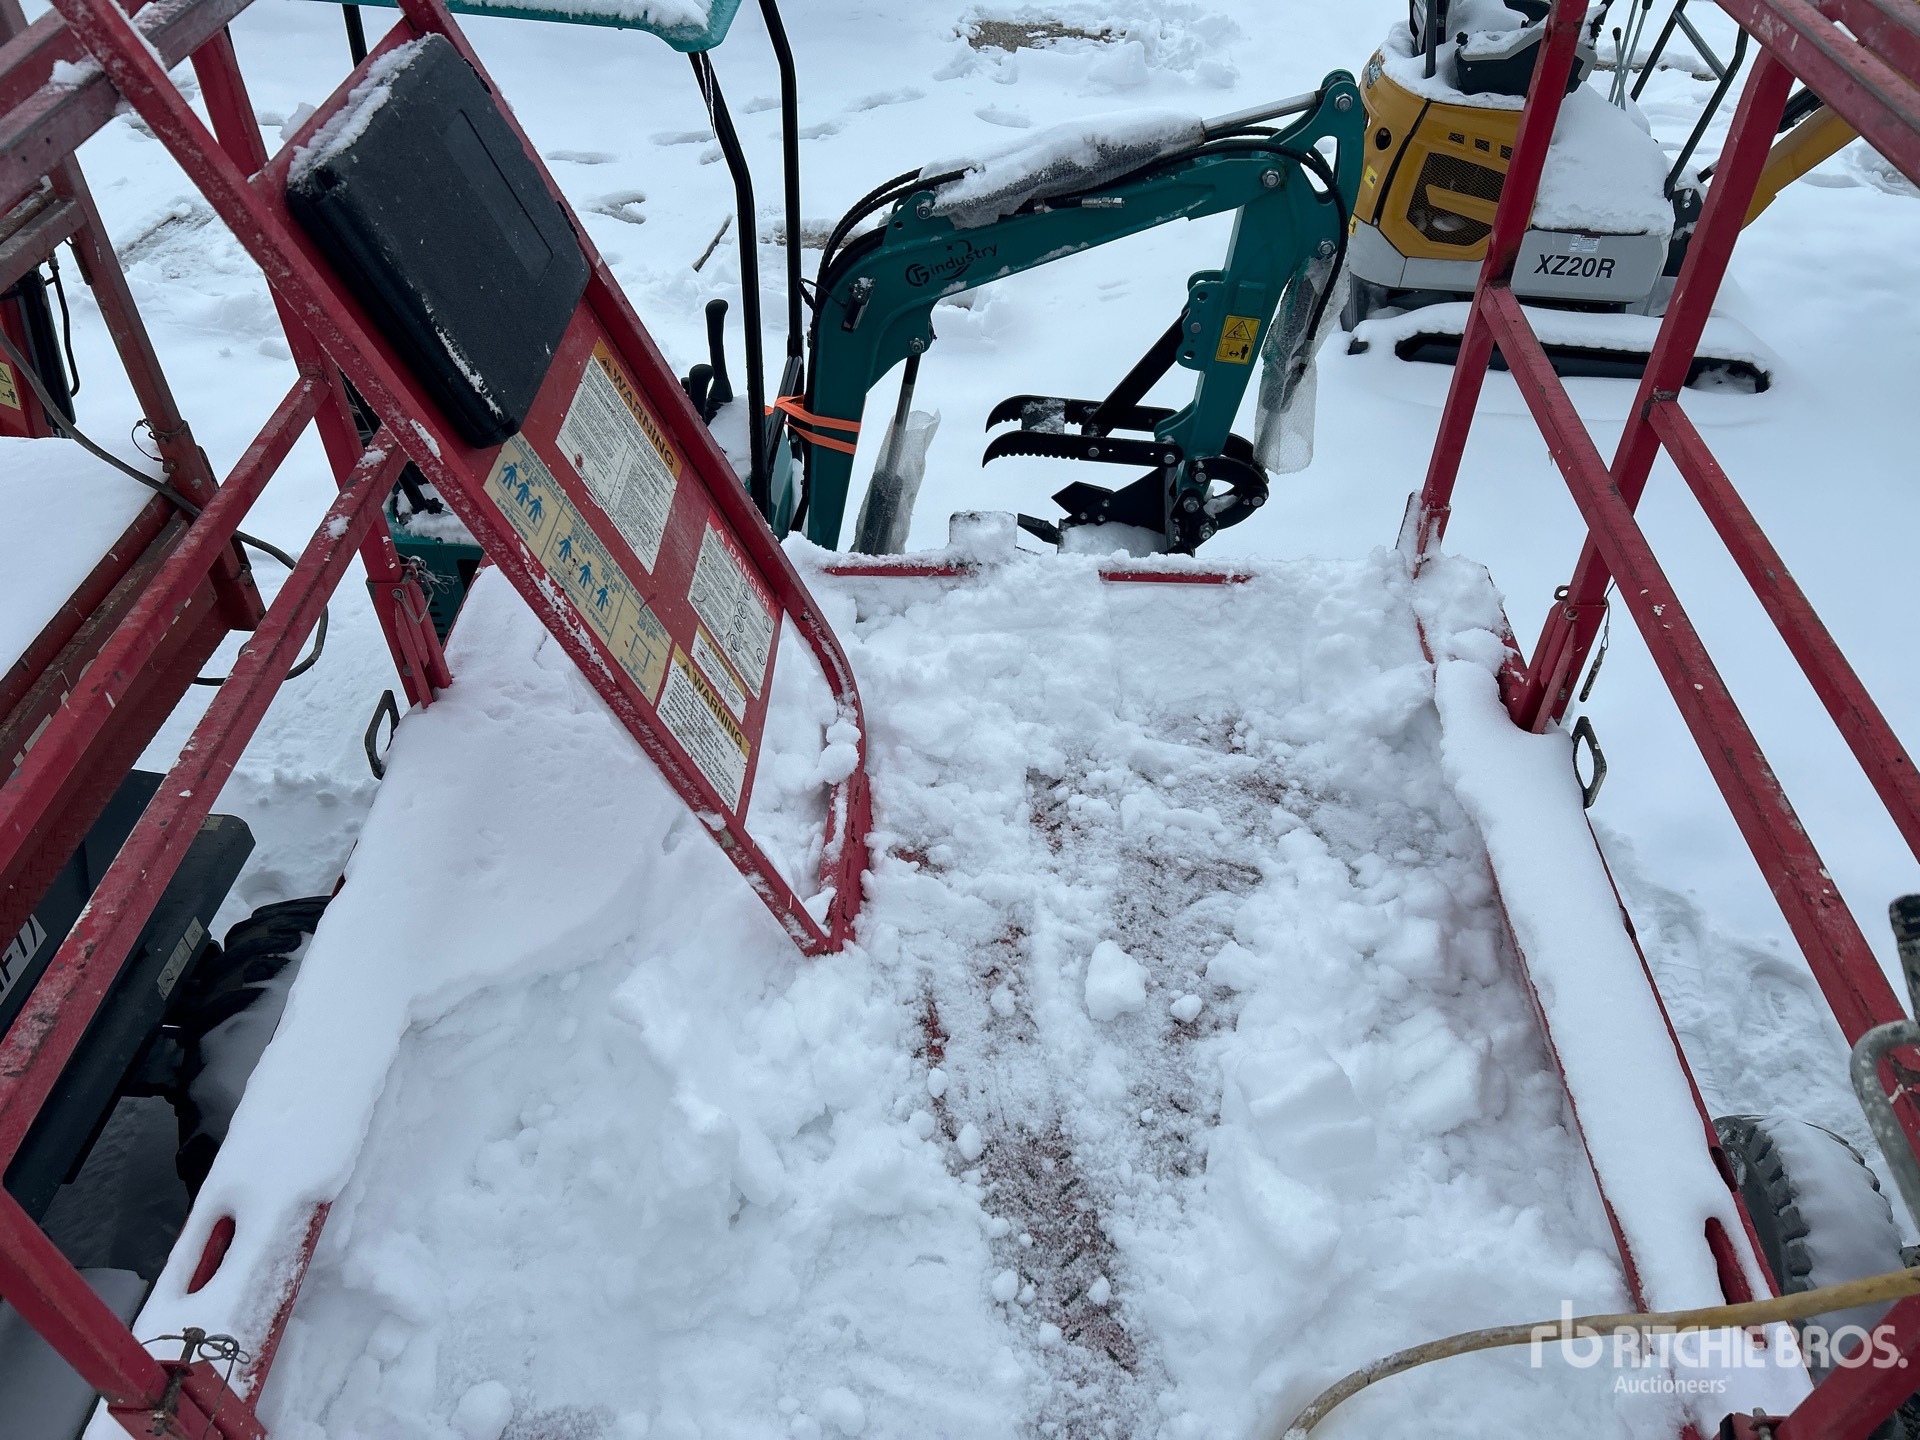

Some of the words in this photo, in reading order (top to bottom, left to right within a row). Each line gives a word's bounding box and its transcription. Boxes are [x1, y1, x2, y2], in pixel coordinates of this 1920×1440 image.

[931, 244, 998, 276] industry
[1534, 254, 1616, 279] XZ20R
[611, 367, 674, 469] WARNING
[495, 496, 529, 541] 3-PERSONS
[527, 447, 556, 486] MAXIMUM
[555, 485, 586, 527] PLATFORM
[585, 525, 612, 562] CAPACITY
[548, 564, 579, 606] 2-PERSONS
[728, 541, 769, 611] DANGER
[584, 602, 609, 638] 1-PERSON
[618, 654, 646, 693] 3-PERSONS
[712, 645, 735, 681] WARNING
[692, 671, 742, 748] WARNING
